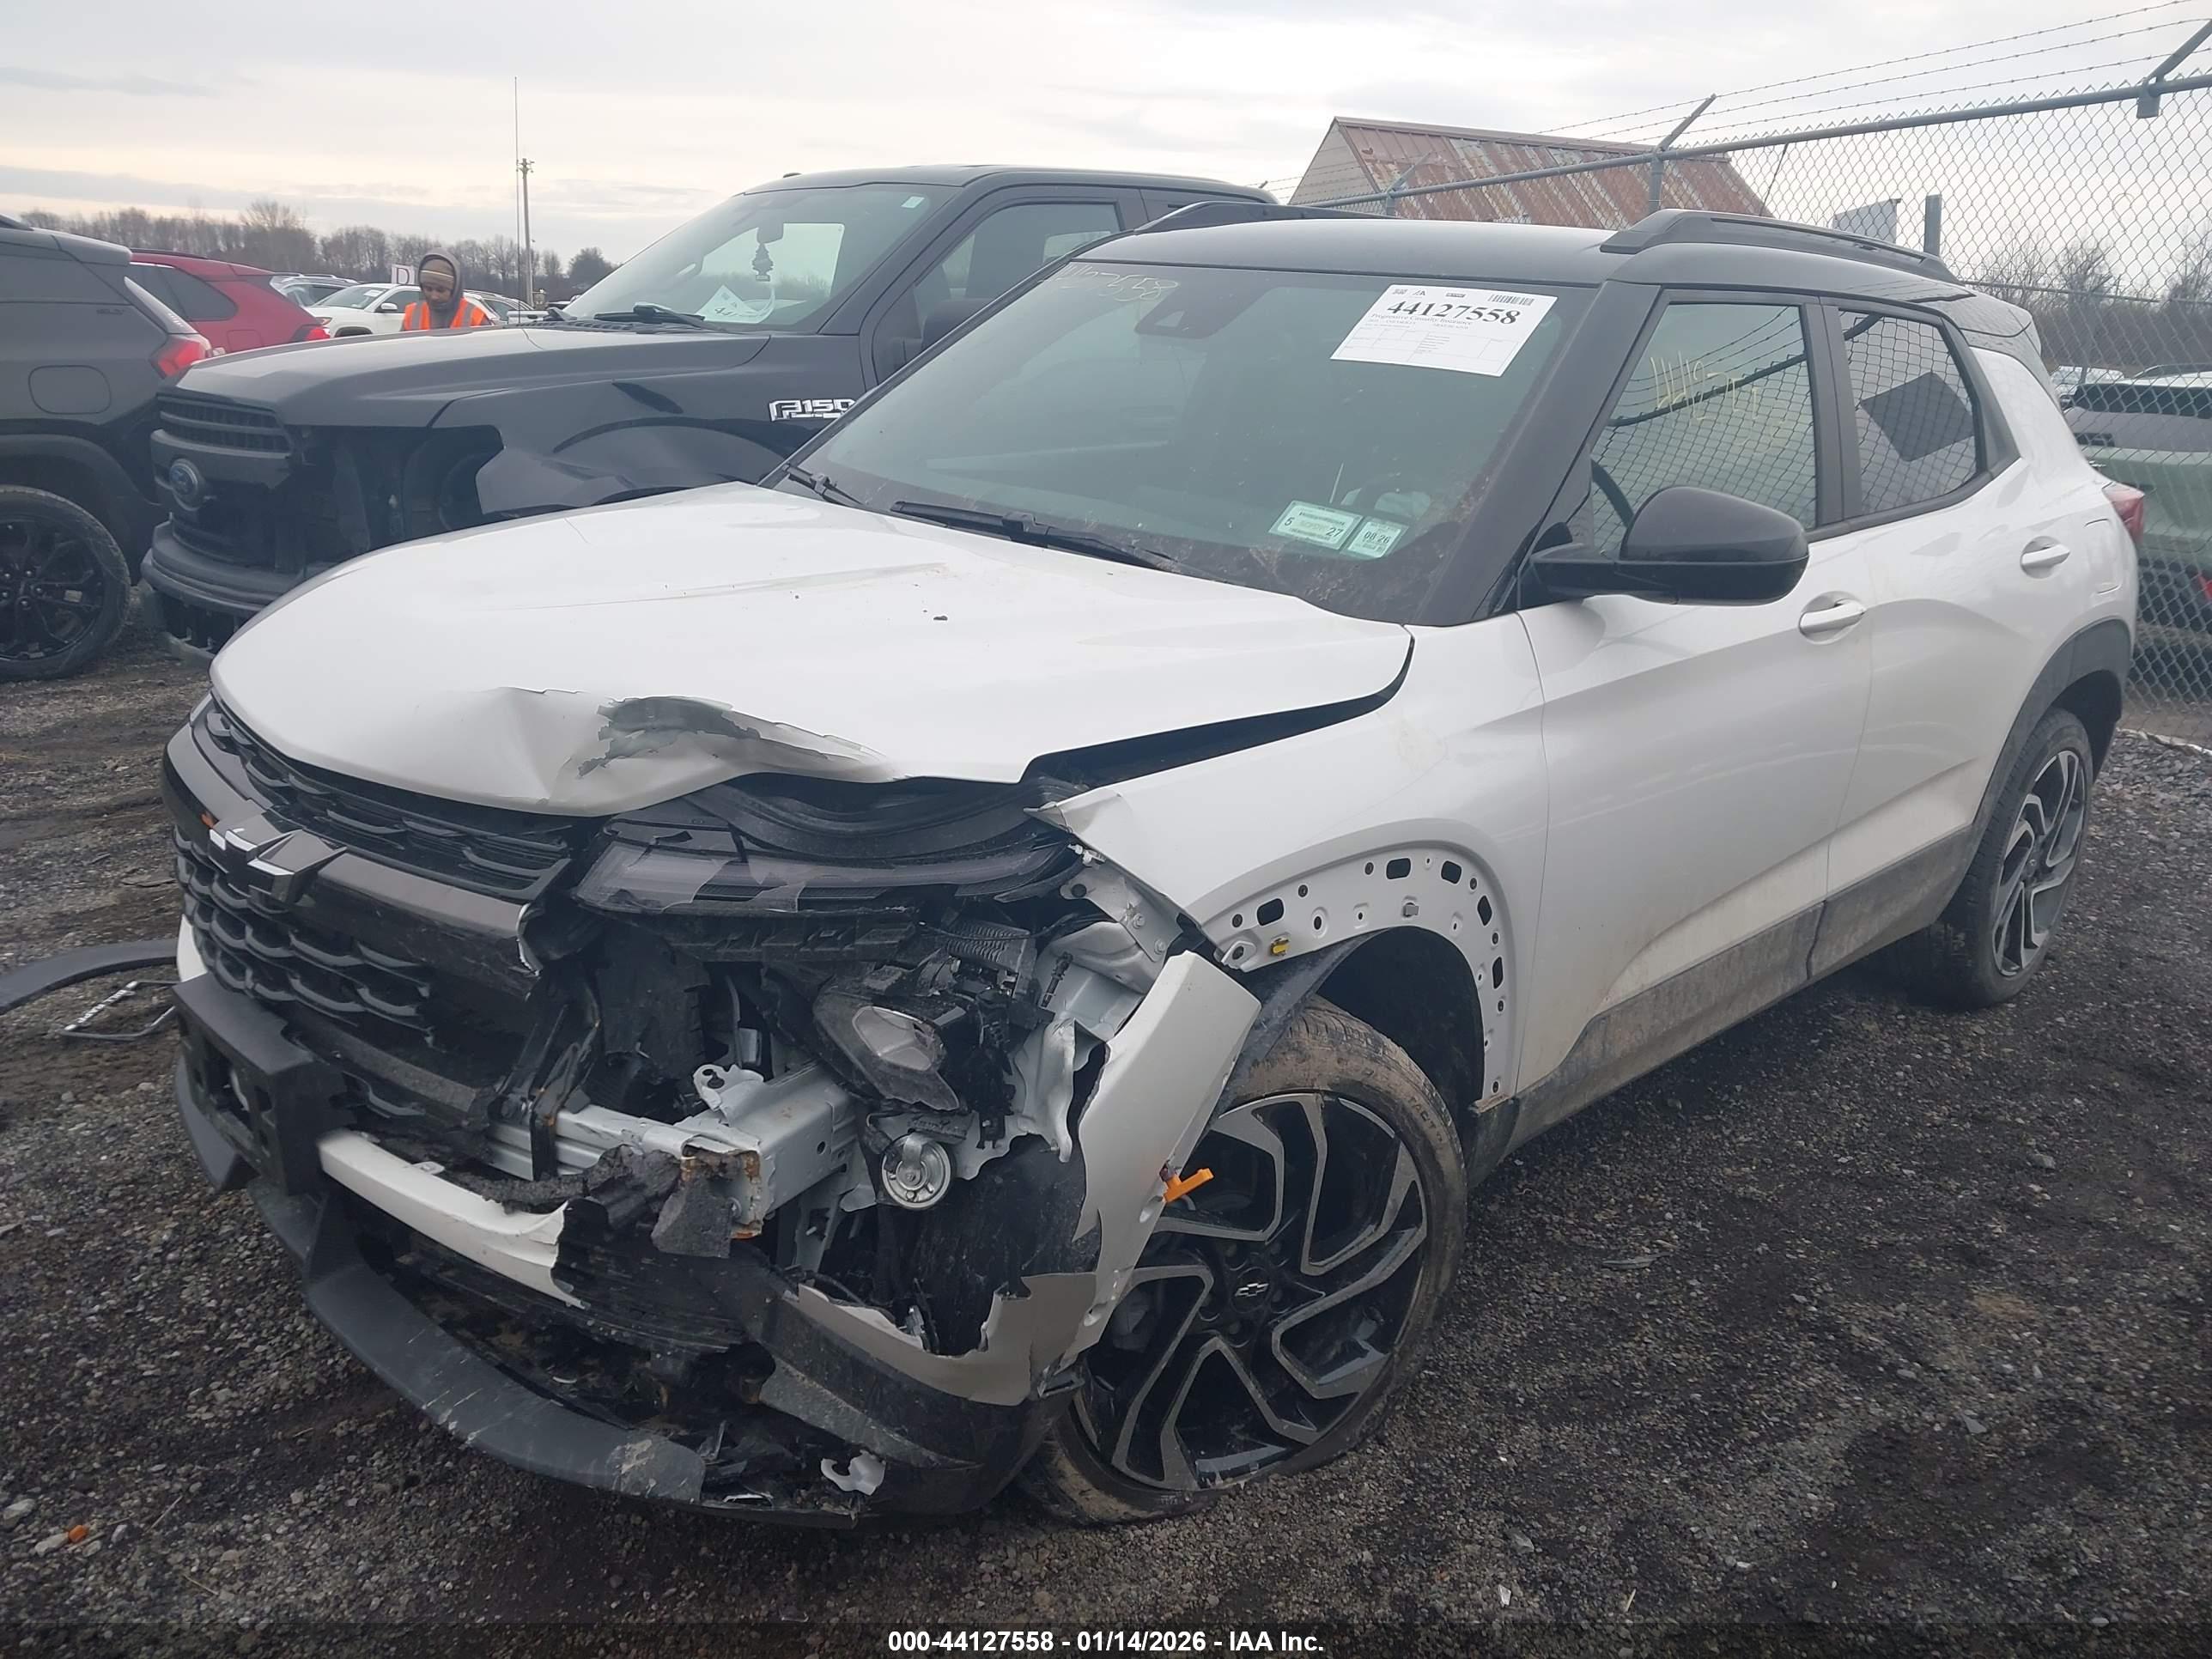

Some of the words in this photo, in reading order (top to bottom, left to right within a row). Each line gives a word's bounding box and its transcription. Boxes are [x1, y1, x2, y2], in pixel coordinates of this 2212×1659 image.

[396, 267, 410, 284] D
[1387, 301, 1521, 325] 44127558
[1325, 527, 1345, 538] 27
